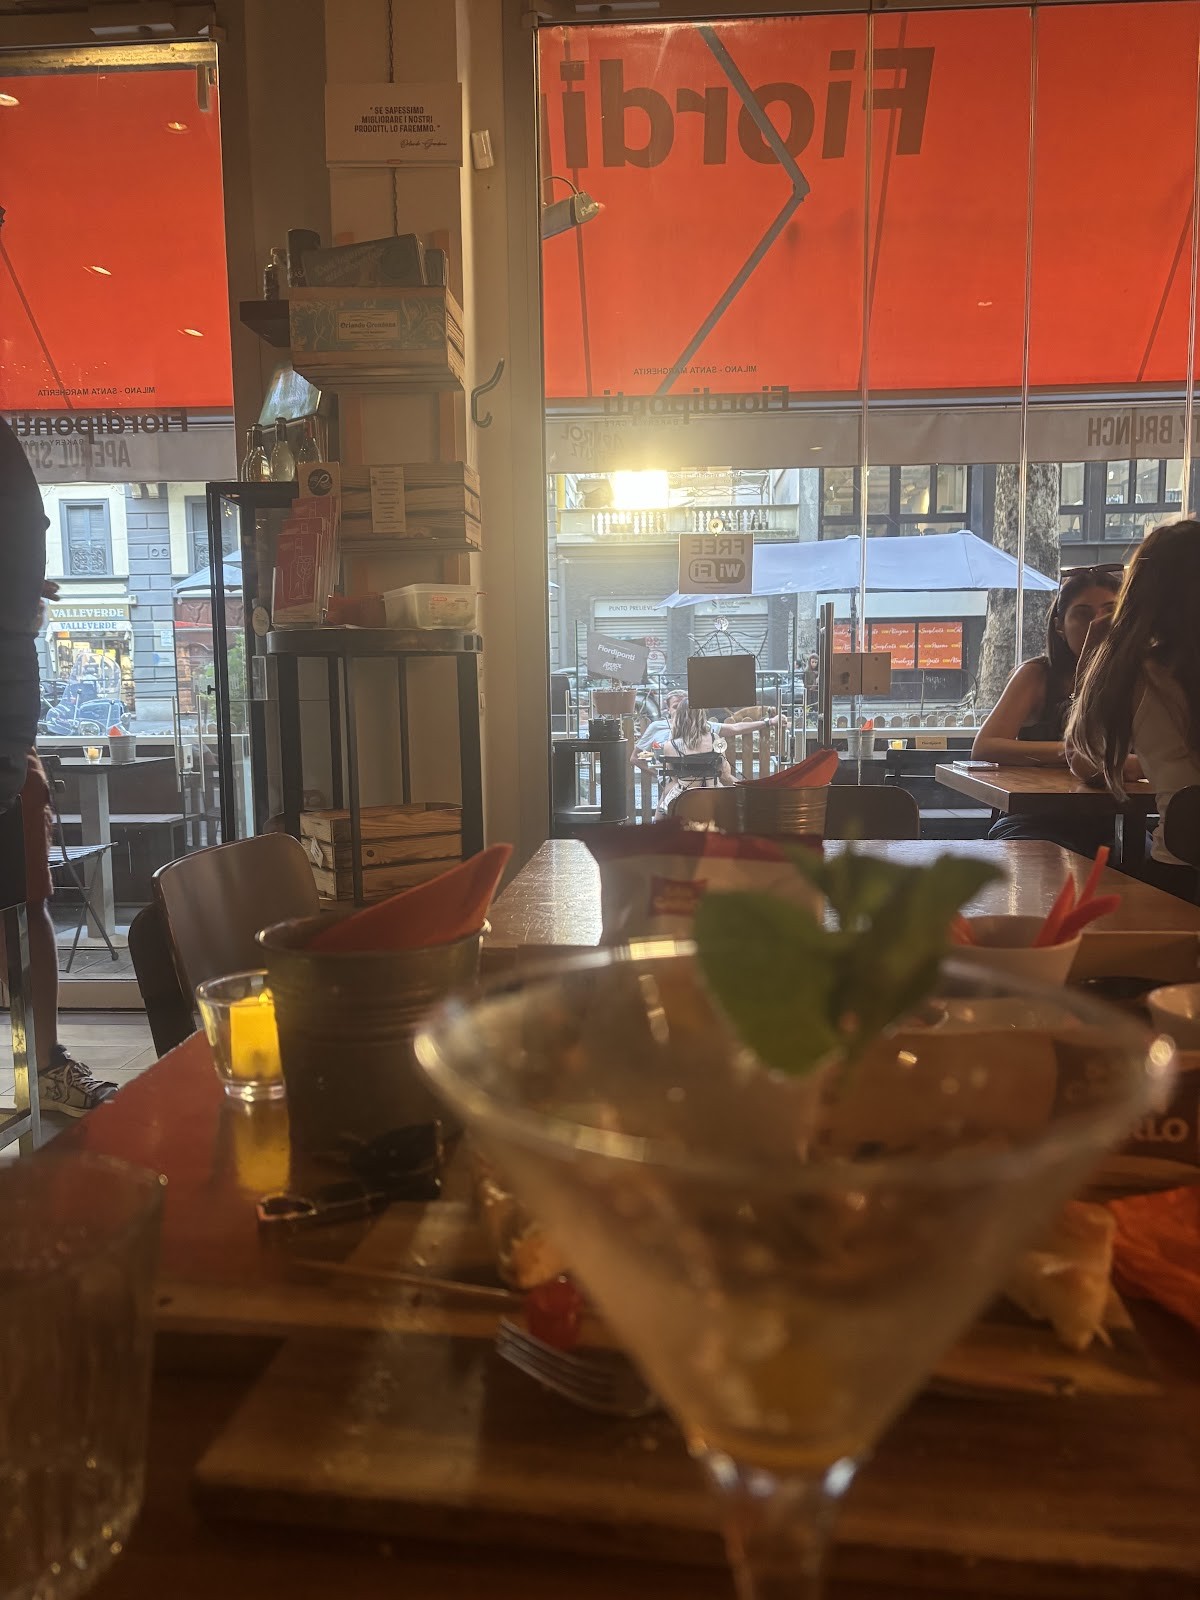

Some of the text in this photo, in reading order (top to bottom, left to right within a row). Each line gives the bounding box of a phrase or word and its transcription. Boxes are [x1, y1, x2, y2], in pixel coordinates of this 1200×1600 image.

[362, 116, 402, 124] MIGLIORARE
[409, 116, 432, 124] NOSTRI
[355, 125, 388, 133] PRODOTTI,
[51, 608, 124, 618] VALLEVERDE
[60, 622, 117, 630] VALLEVERDE
[598, 644, 636, 661] Fiordiponti
